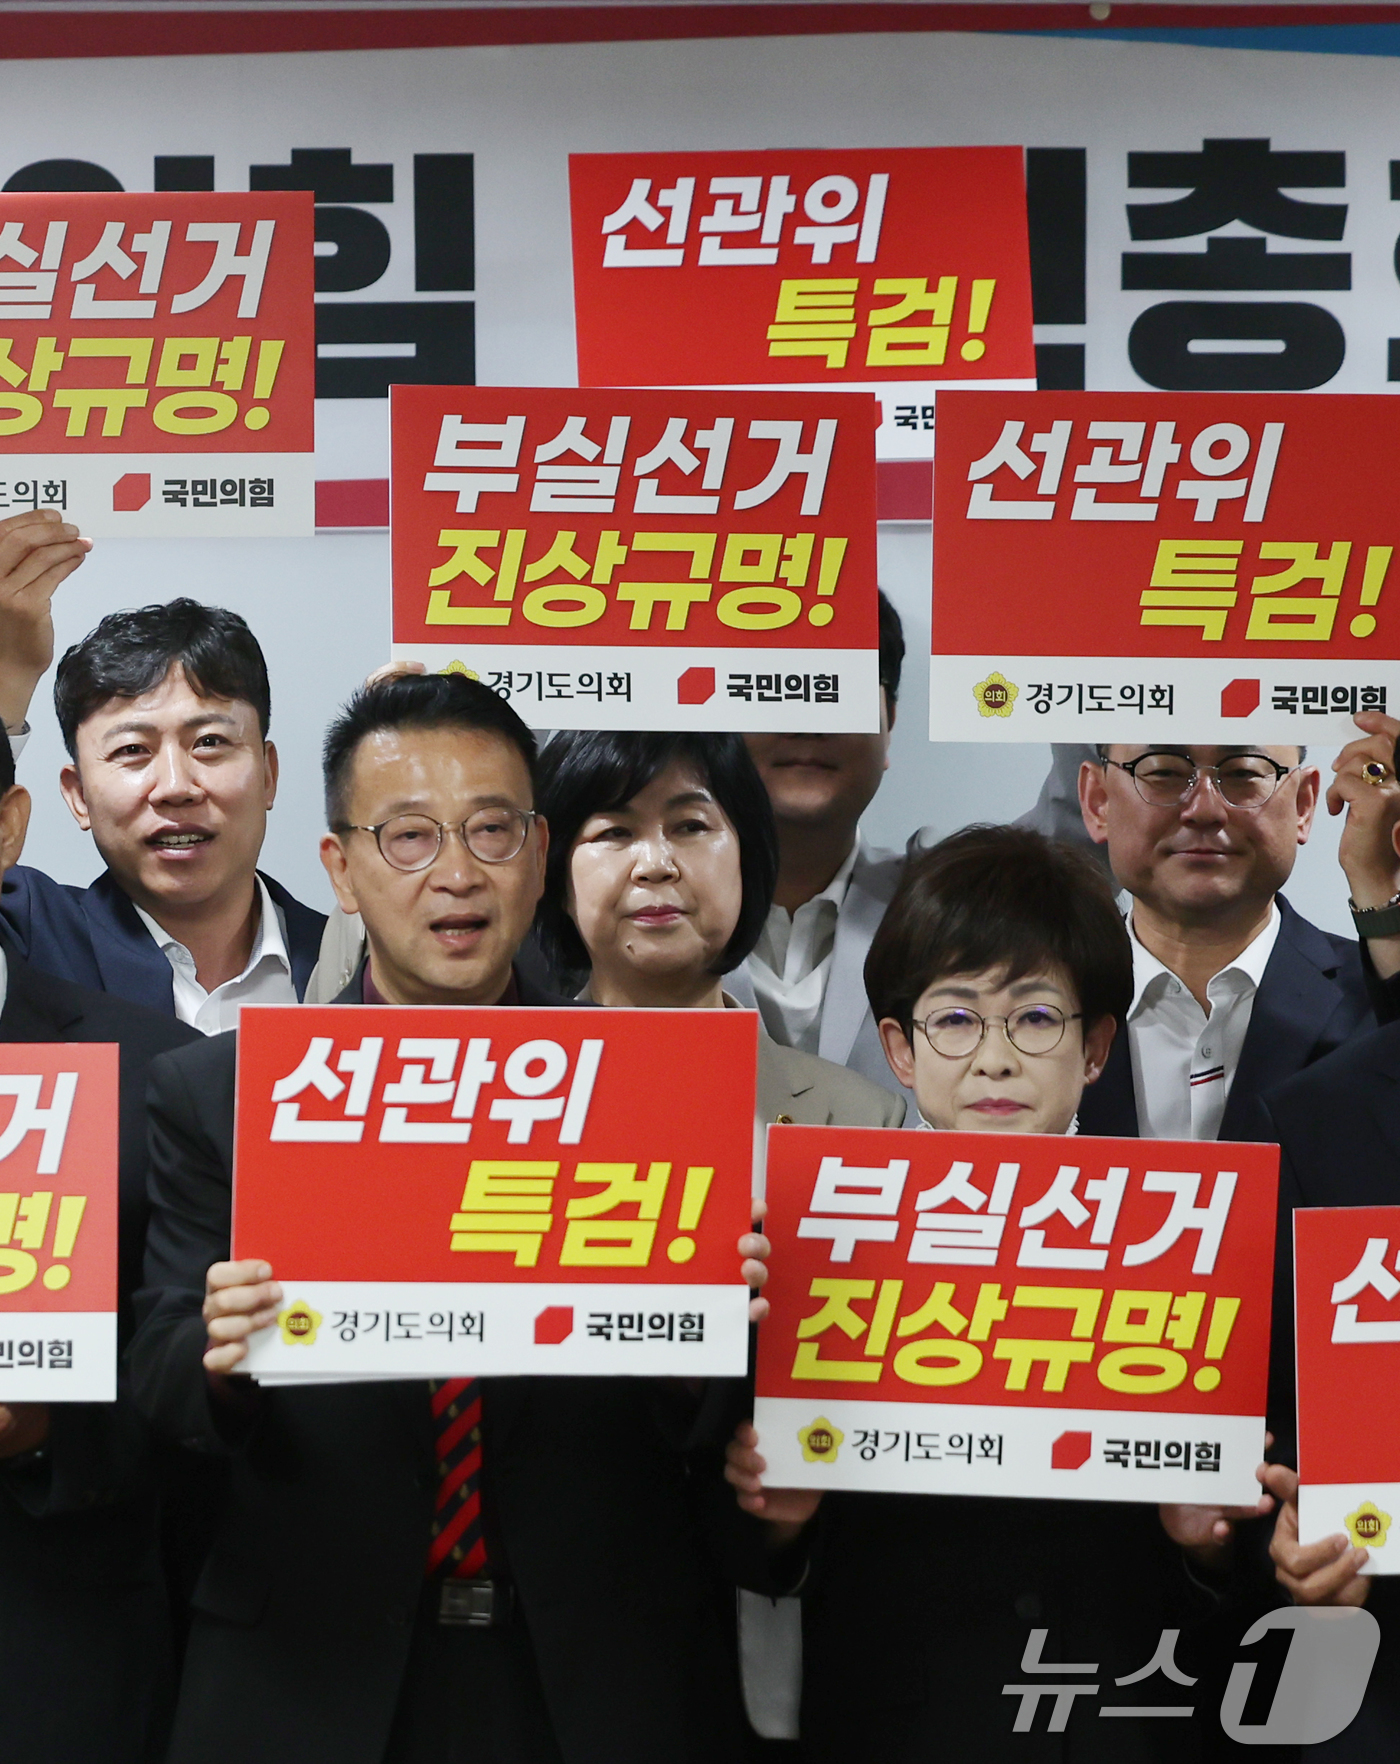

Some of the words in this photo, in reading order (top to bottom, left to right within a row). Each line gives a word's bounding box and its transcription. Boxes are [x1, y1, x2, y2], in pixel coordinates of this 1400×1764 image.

[601, 172, 889, 268] 선관위
[0, 146, 476, 399] 힘
[766, 275, 996, 369] 특검!
[162, 477, 274, 508] 국민의힘
[422, 414, 838, 516] 부실선거
[966, 420, 1285, 523] 선관위
[425, 529, 848, 631] 진상규명!
[1139, 539, 1394, 641] 특검!
[487, 671, 632, 703] 경기도의회
[726, 673, 839, 703] 국민의힘
[1026, 683, 1174, 716] 경기도의회
[1271, 685, 1387, 715] 국민의힘
[269, 1036, 605, 1145] 선관위
[448, 1160, 715, 1267] 특검!
[796, 1156, 1239, 1275] 부실선거
[331, 1310, 485, 1342] 경기도의회
[586, 1312, 705, 1342] 국민의힘
[791, 1278, 1241, 1394] 진상규명!
[851, 1428, 1003, 1466] 경기도의회
[1103, 1438, 1222, 1473] 국민의힘
